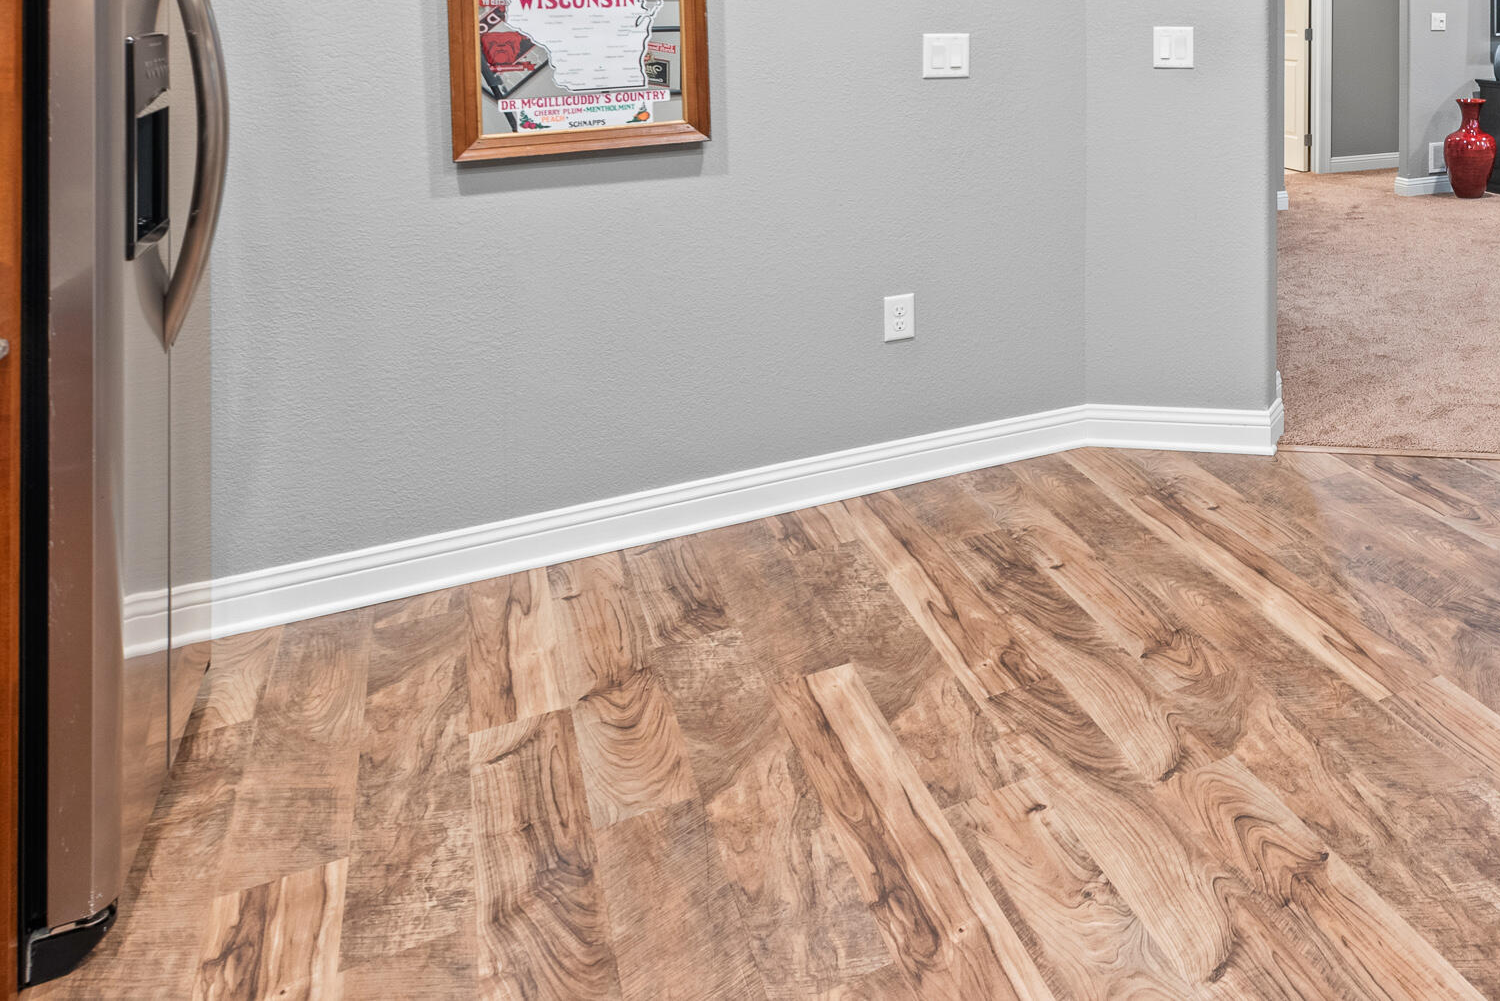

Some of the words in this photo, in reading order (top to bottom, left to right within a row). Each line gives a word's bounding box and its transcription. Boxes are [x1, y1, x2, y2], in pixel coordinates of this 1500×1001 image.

[615, 90, 667, 103] COUNTRY
[562, 107, 583, 115] PLUM
[568, 119, 607, 128] SCHNAPPS
